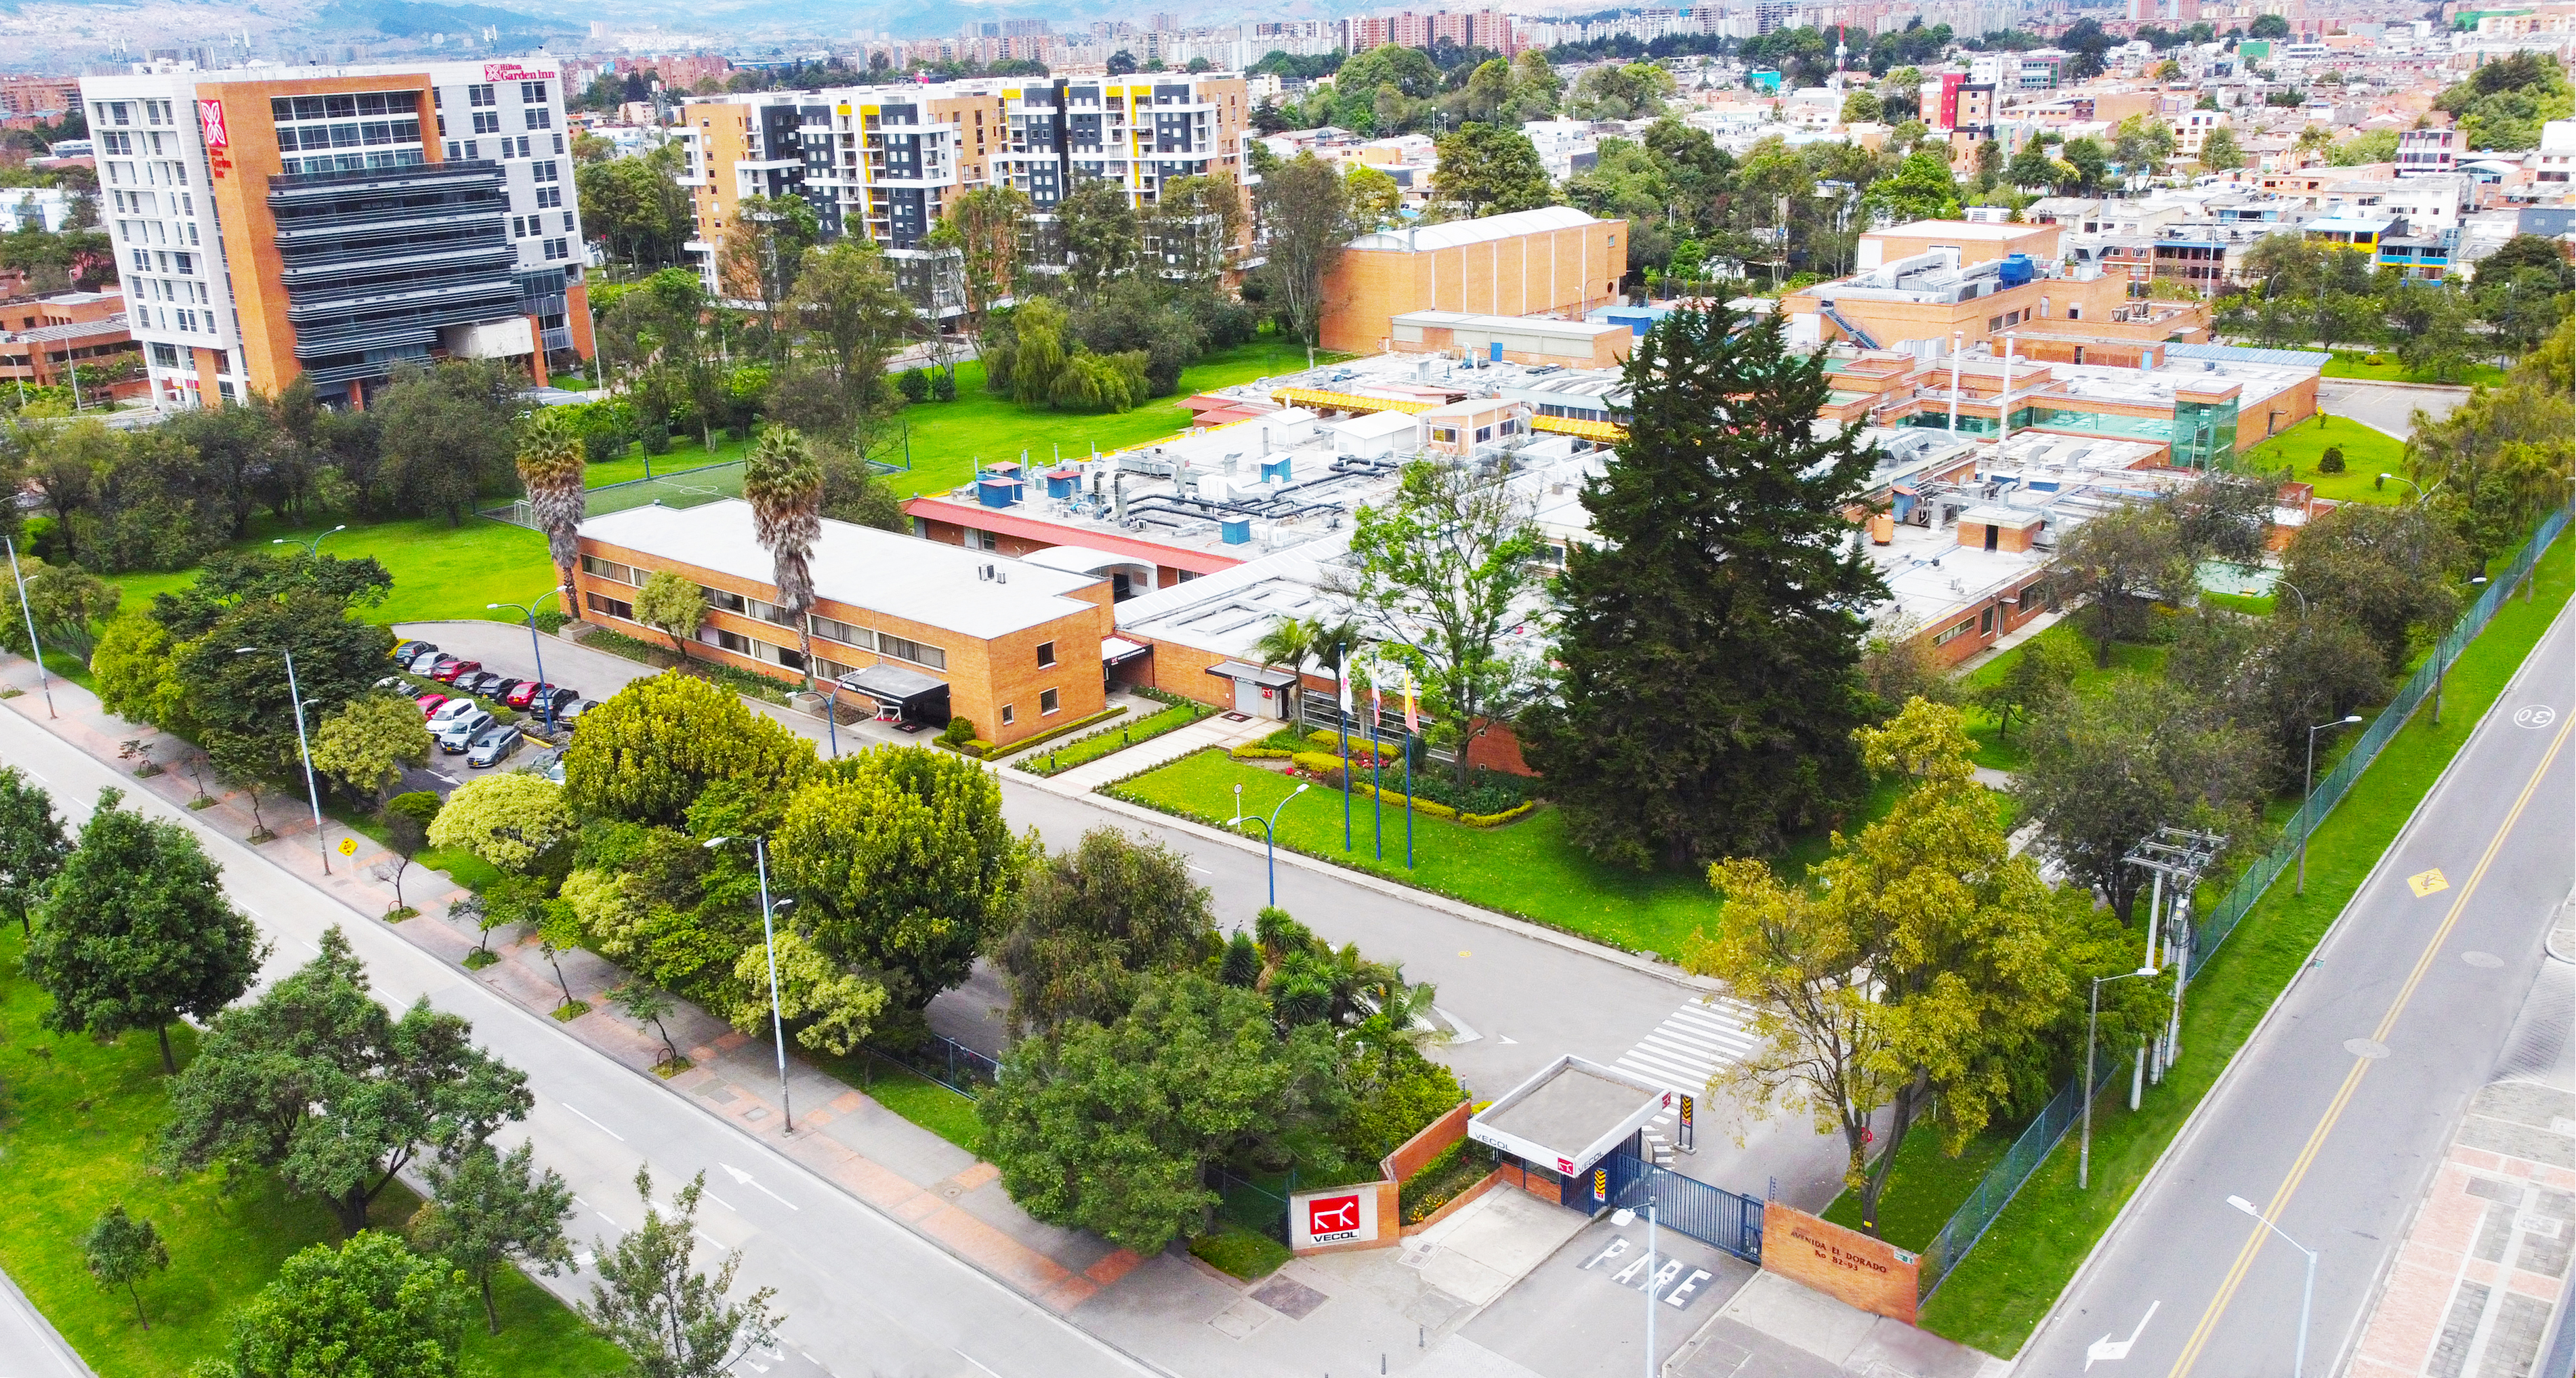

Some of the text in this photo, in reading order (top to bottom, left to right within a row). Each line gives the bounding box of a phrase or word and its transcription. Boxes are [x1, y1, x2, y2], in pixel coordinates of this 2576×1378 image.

[501, 70, 555, 81] Garden Inn
[2519, 709, 2551, 724] 30
[1474, 1132, 1512, 1151] VECOL
[1578, 1151, 1604, 1172] VECOL
[1314, 1232, 1357, 1243] VECOL
[1791, 1231, 1827, 1251] AVENIDA
[1831, 1247, 1841, 1256] EL
[1846, 1253, 1886, 1273] DORADO
[1815, 1250, 1858, 1272] No 82-93
[1585, 1238, 1713, 1307] PARE
